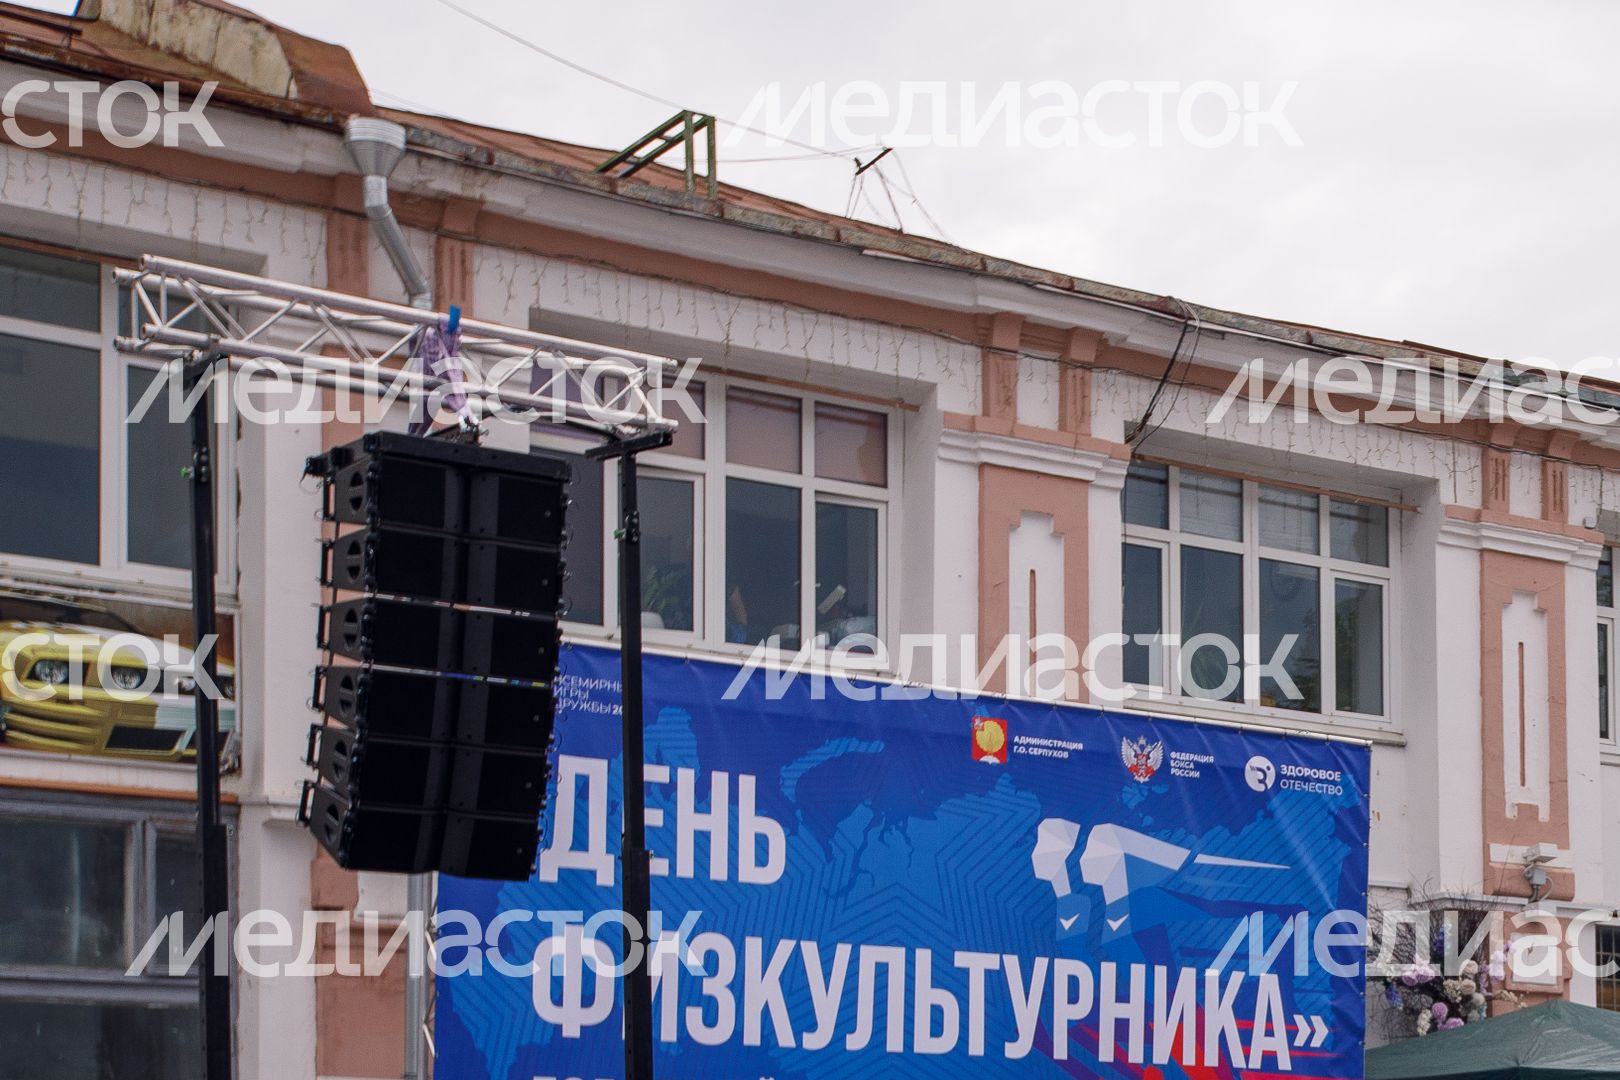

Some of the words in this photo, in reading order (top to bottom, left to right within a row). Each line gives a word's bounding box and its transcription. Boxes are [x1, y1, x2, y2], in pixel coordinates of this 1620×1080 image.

[1013, 735, 1083, 750] АДМИНИСТРАЦИЯ
[1028, 747, 1069, 759] СЕРПУХОВ
[1170, 751, 1215, 763] ФЕДЕРАЦИЯ
[1170, 760, 1194, 769] БОКСА
[1170, 768, 1200, 778] РОССИИ
[1280, 764, 1341, 781] ЗДОРОВОЕ
[1280, 779, 1343, 796] ОТЕЧЕСТВО
[539, 754, 786, 887] ДЕНЬ
[532, 925, 1329, 1071] ФИЗКУЛЬТУРНИКА»
